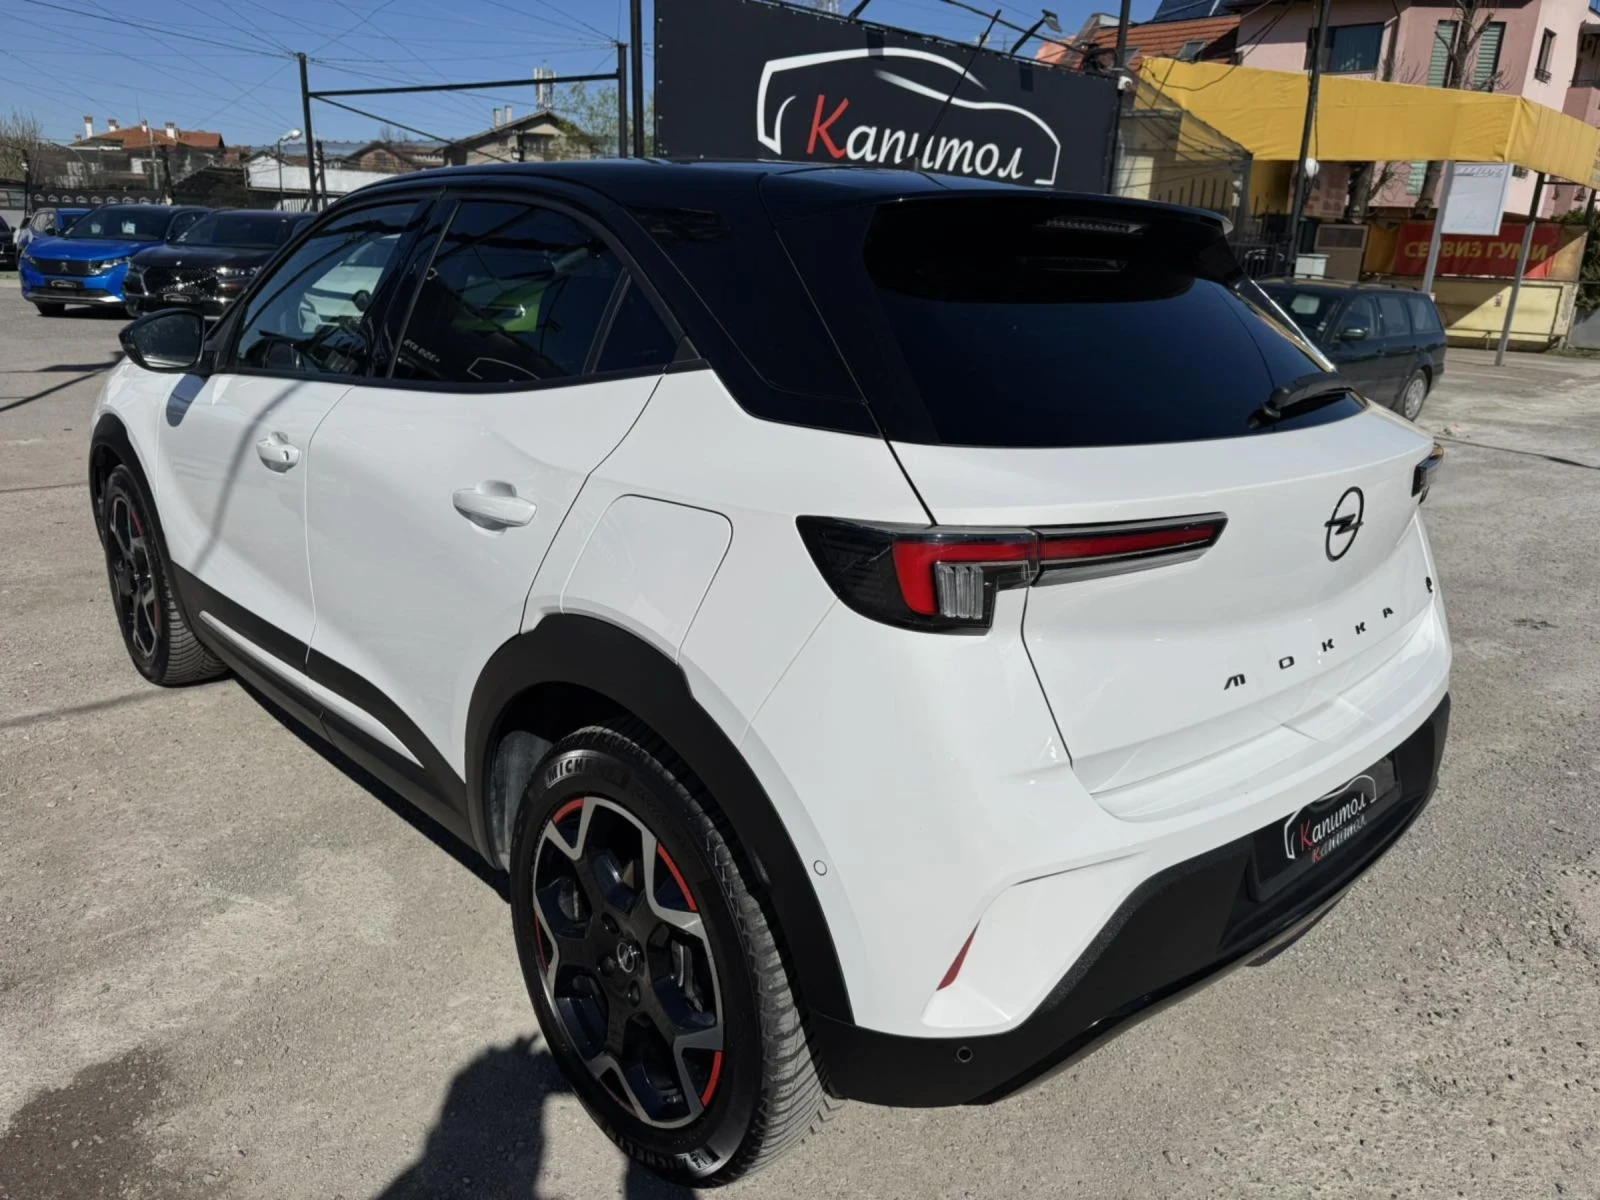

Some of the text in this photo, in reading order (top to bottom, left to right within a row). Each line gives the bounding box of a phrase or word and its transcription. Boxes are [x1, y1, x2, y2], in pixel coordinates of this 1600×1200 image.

[1404, 241, 1482, 258] СЕВИЗ
[1223, 607, 1394, 690] MOKKA
[1300, 792, 1366, 850] Капитол
